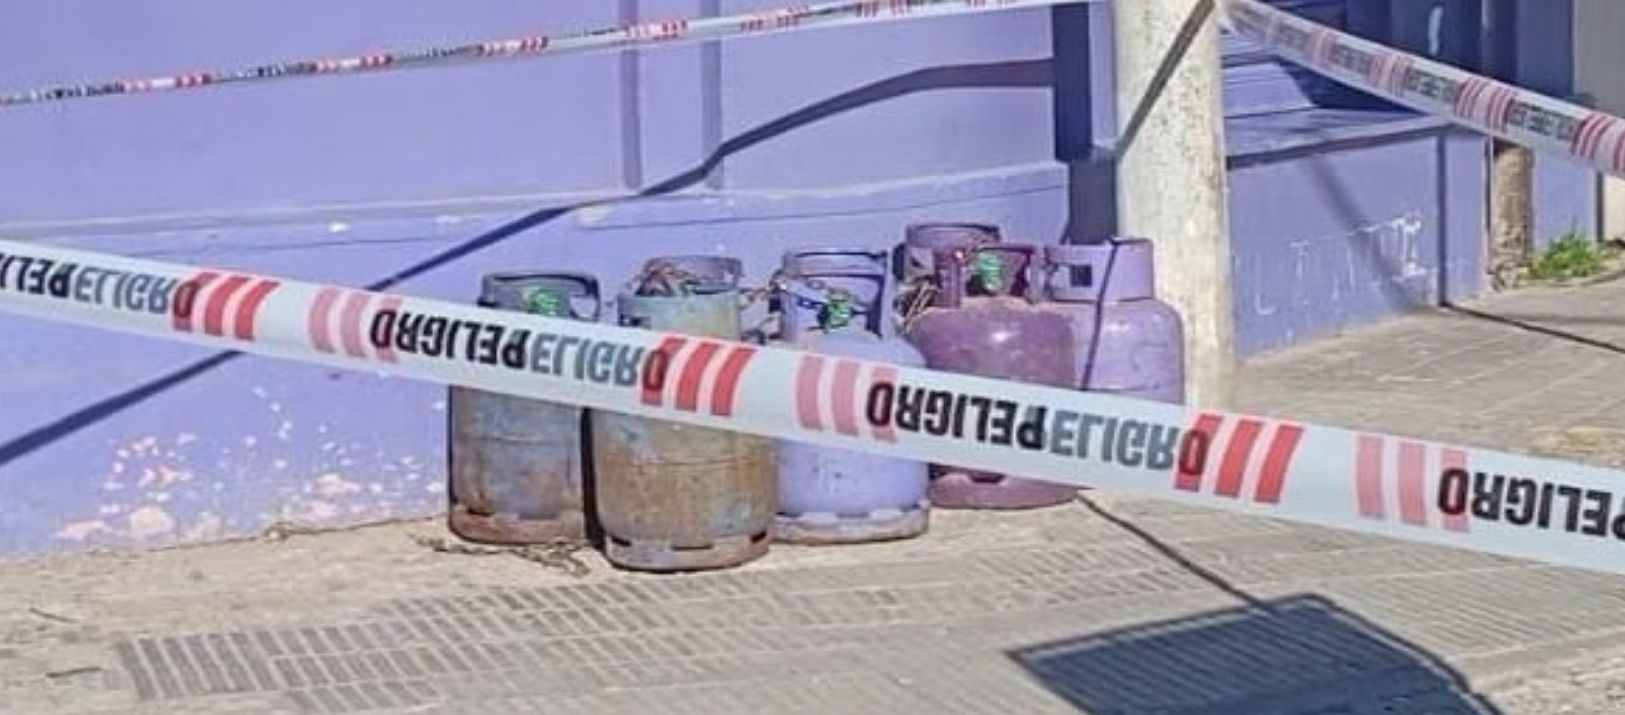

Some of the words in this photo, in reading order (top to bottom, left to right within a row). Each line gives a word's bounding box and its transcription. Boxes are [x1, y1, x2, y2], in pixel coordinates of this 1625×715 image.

[0, 253, 77, 298] PELI
[369, 308, 531, 369] PELIGRO
[865, 380, 1047, 451] PELIGRO
